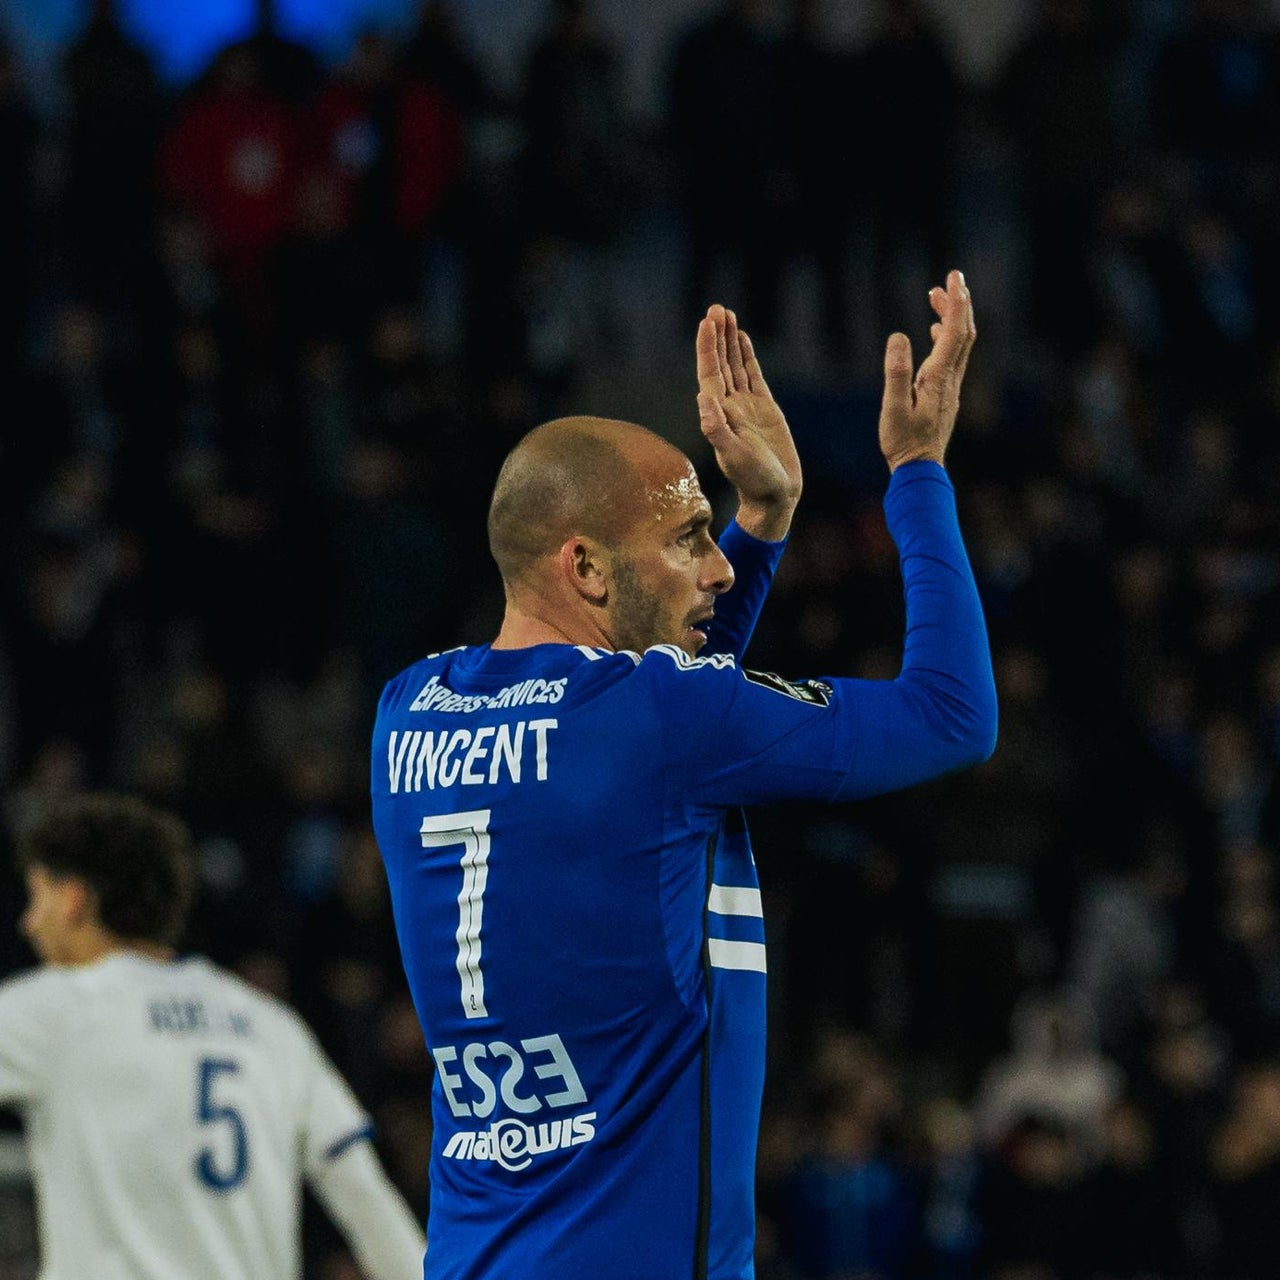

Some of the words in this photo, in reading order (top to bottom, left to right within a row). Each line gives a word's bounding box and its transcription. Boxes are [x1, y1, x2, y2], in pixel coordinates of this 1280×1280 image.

[487, 676, 568, 710] ERVICES
[388, 718, 559, 794] VINCENT
[420, 809, 491, 1019] 7
[196, 1053, 250, 1192] 5
